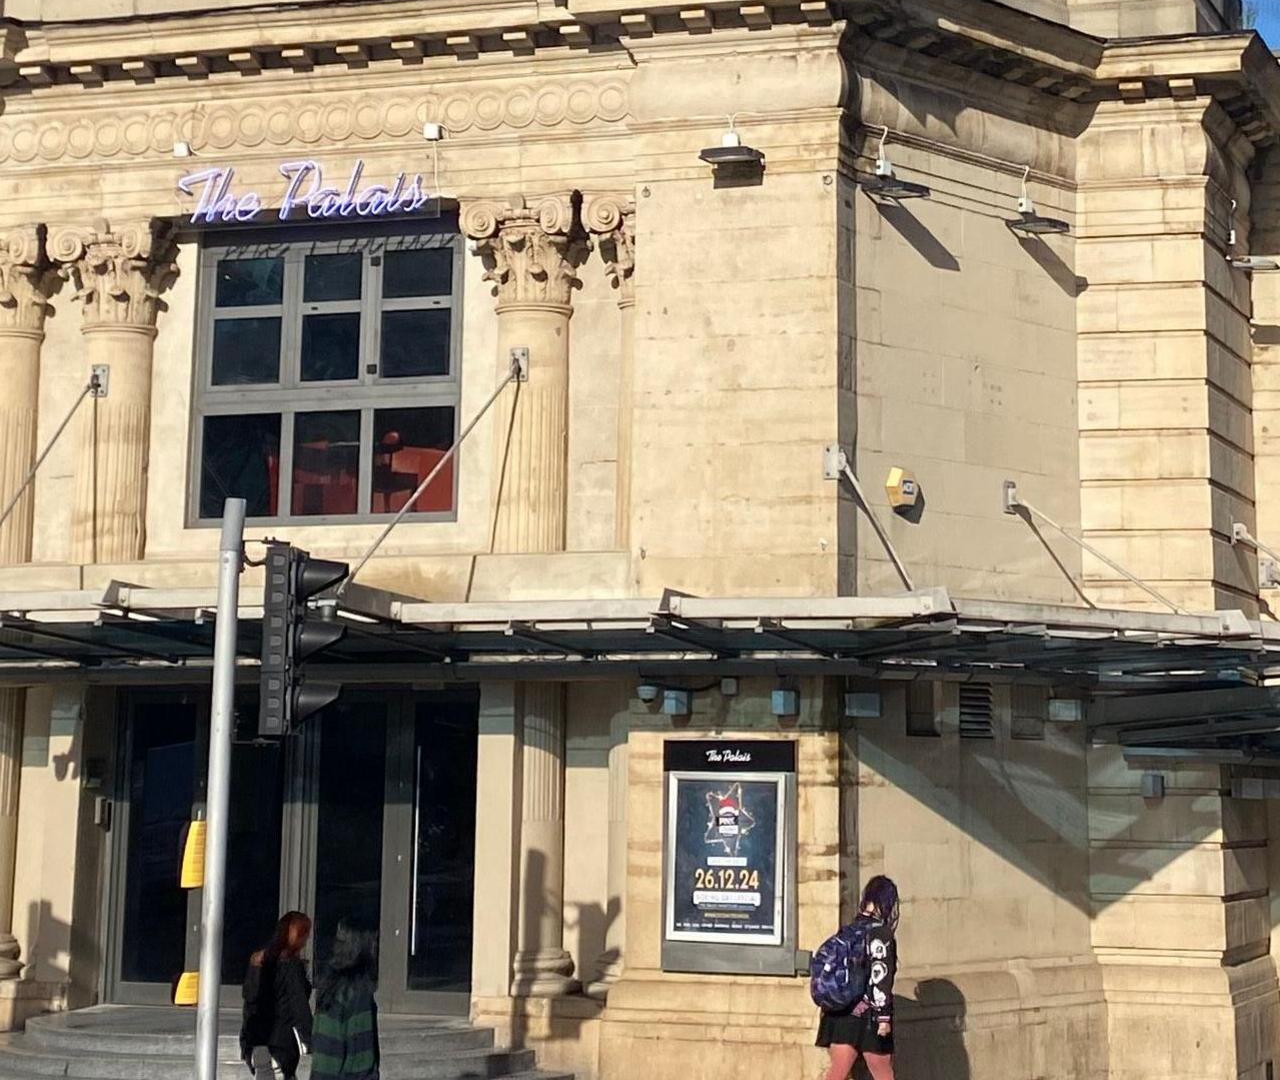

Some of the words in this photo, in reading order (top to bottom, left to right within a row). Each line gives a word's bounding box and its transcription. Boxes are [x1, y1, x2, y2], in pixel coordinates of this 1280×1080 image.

[178, 167, 262, 223] The
[279, 159, 429, 221] Palais
[705, 749, 722, 762] The
[722, 749, 751, 763] Palais
[695, 869, 759, 890] 26.12.24
